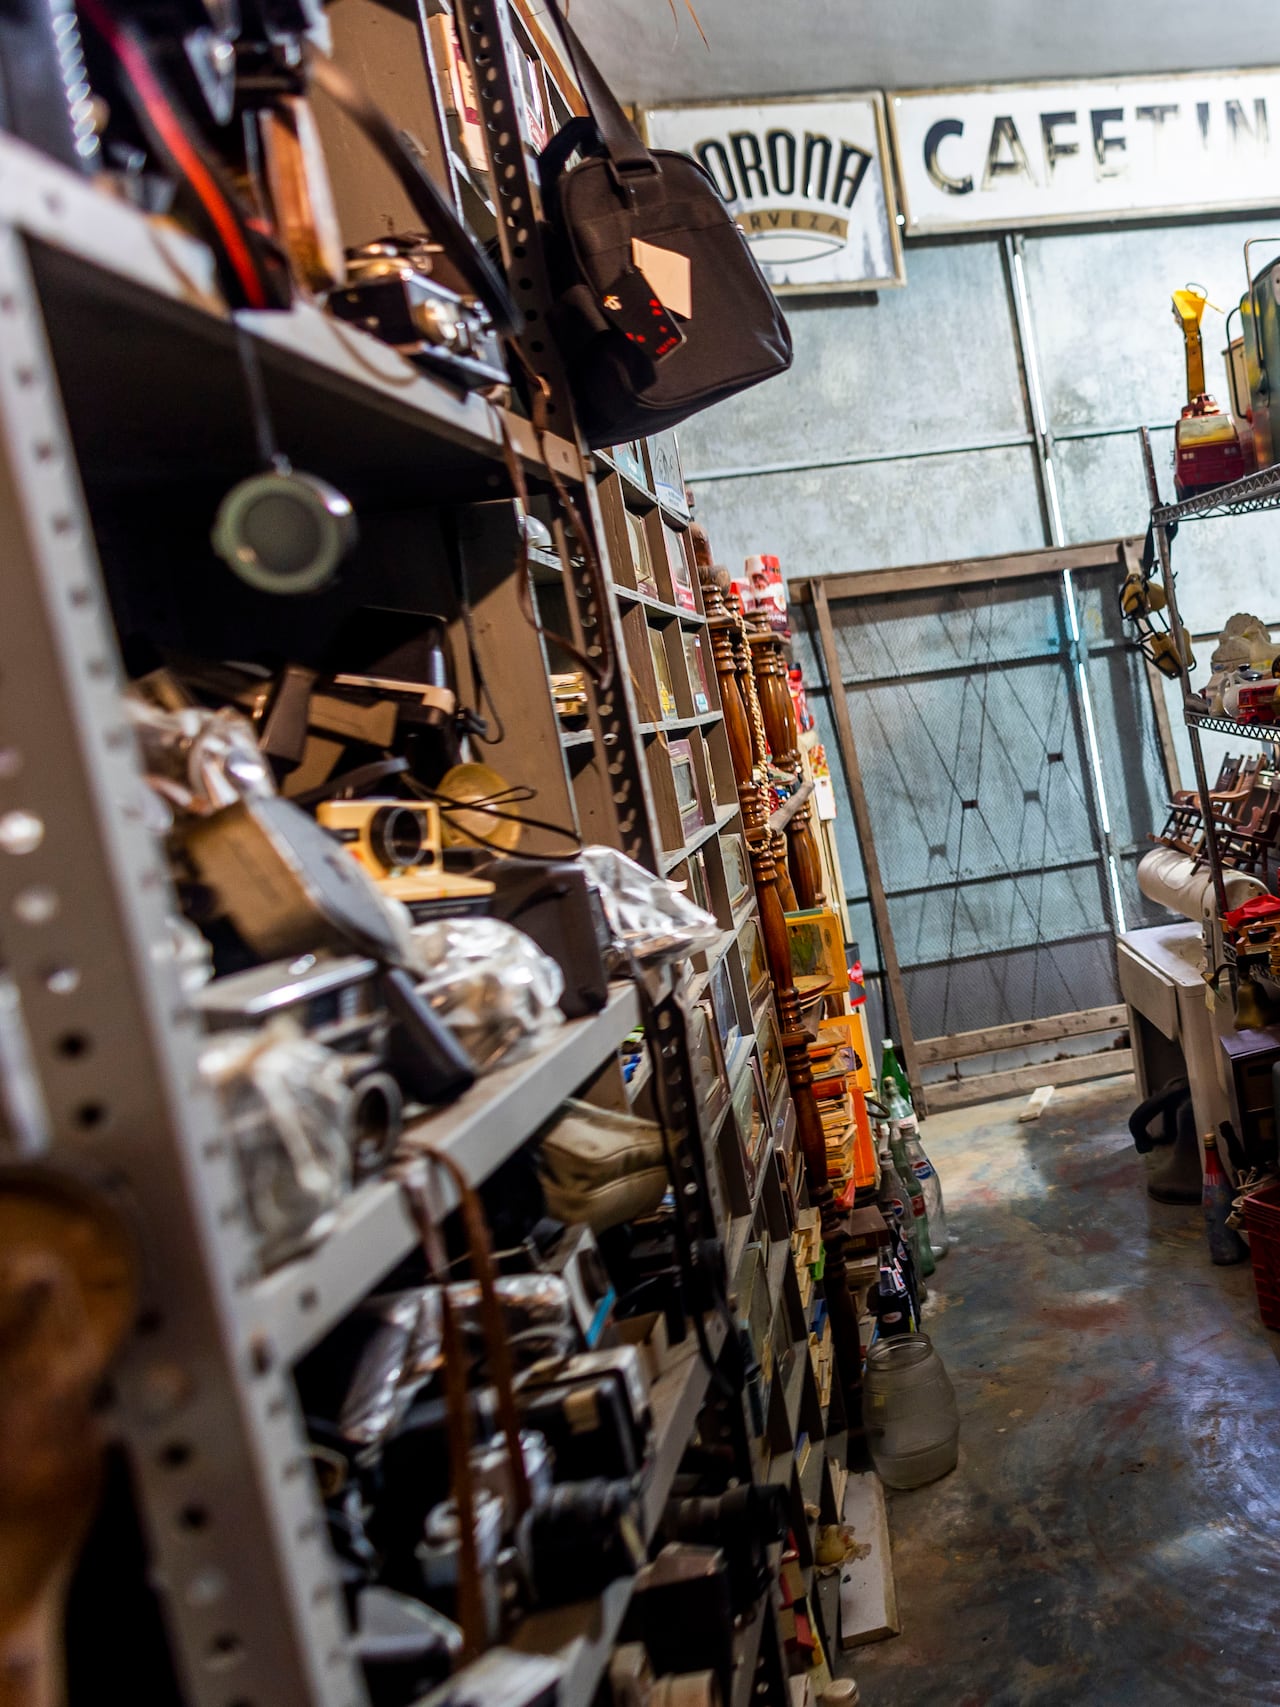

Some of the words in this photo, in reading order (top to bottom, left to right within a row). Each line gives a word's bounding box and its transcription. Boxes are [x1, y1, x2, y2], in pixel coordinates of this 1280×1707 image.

[693, 127, 873, 209] ORONA
[923, 97, 1270, 196] CAFETIN
[750, 212, 843, 236] RVEZA
